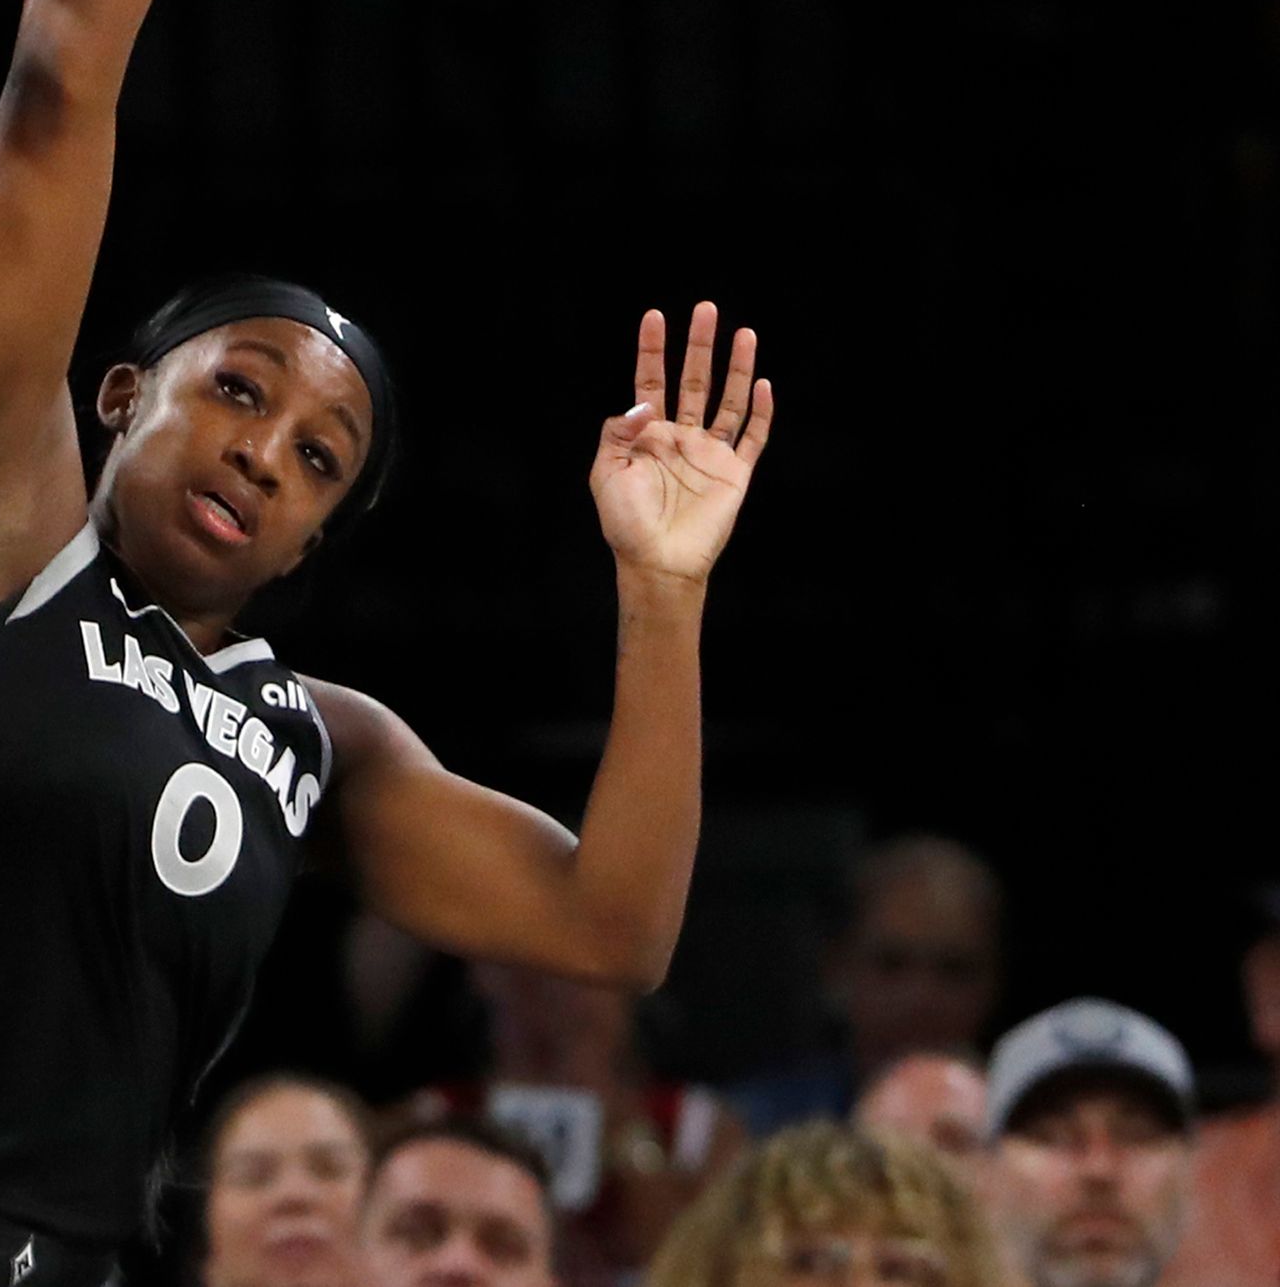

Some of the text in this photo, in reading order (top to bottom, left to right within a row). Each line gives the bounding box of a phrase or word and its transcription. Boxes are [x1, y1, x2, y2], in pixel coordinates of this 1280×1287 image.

[79, 620, 322, 838] LAS VEGAS
[151, 762, 244, 897] 0
